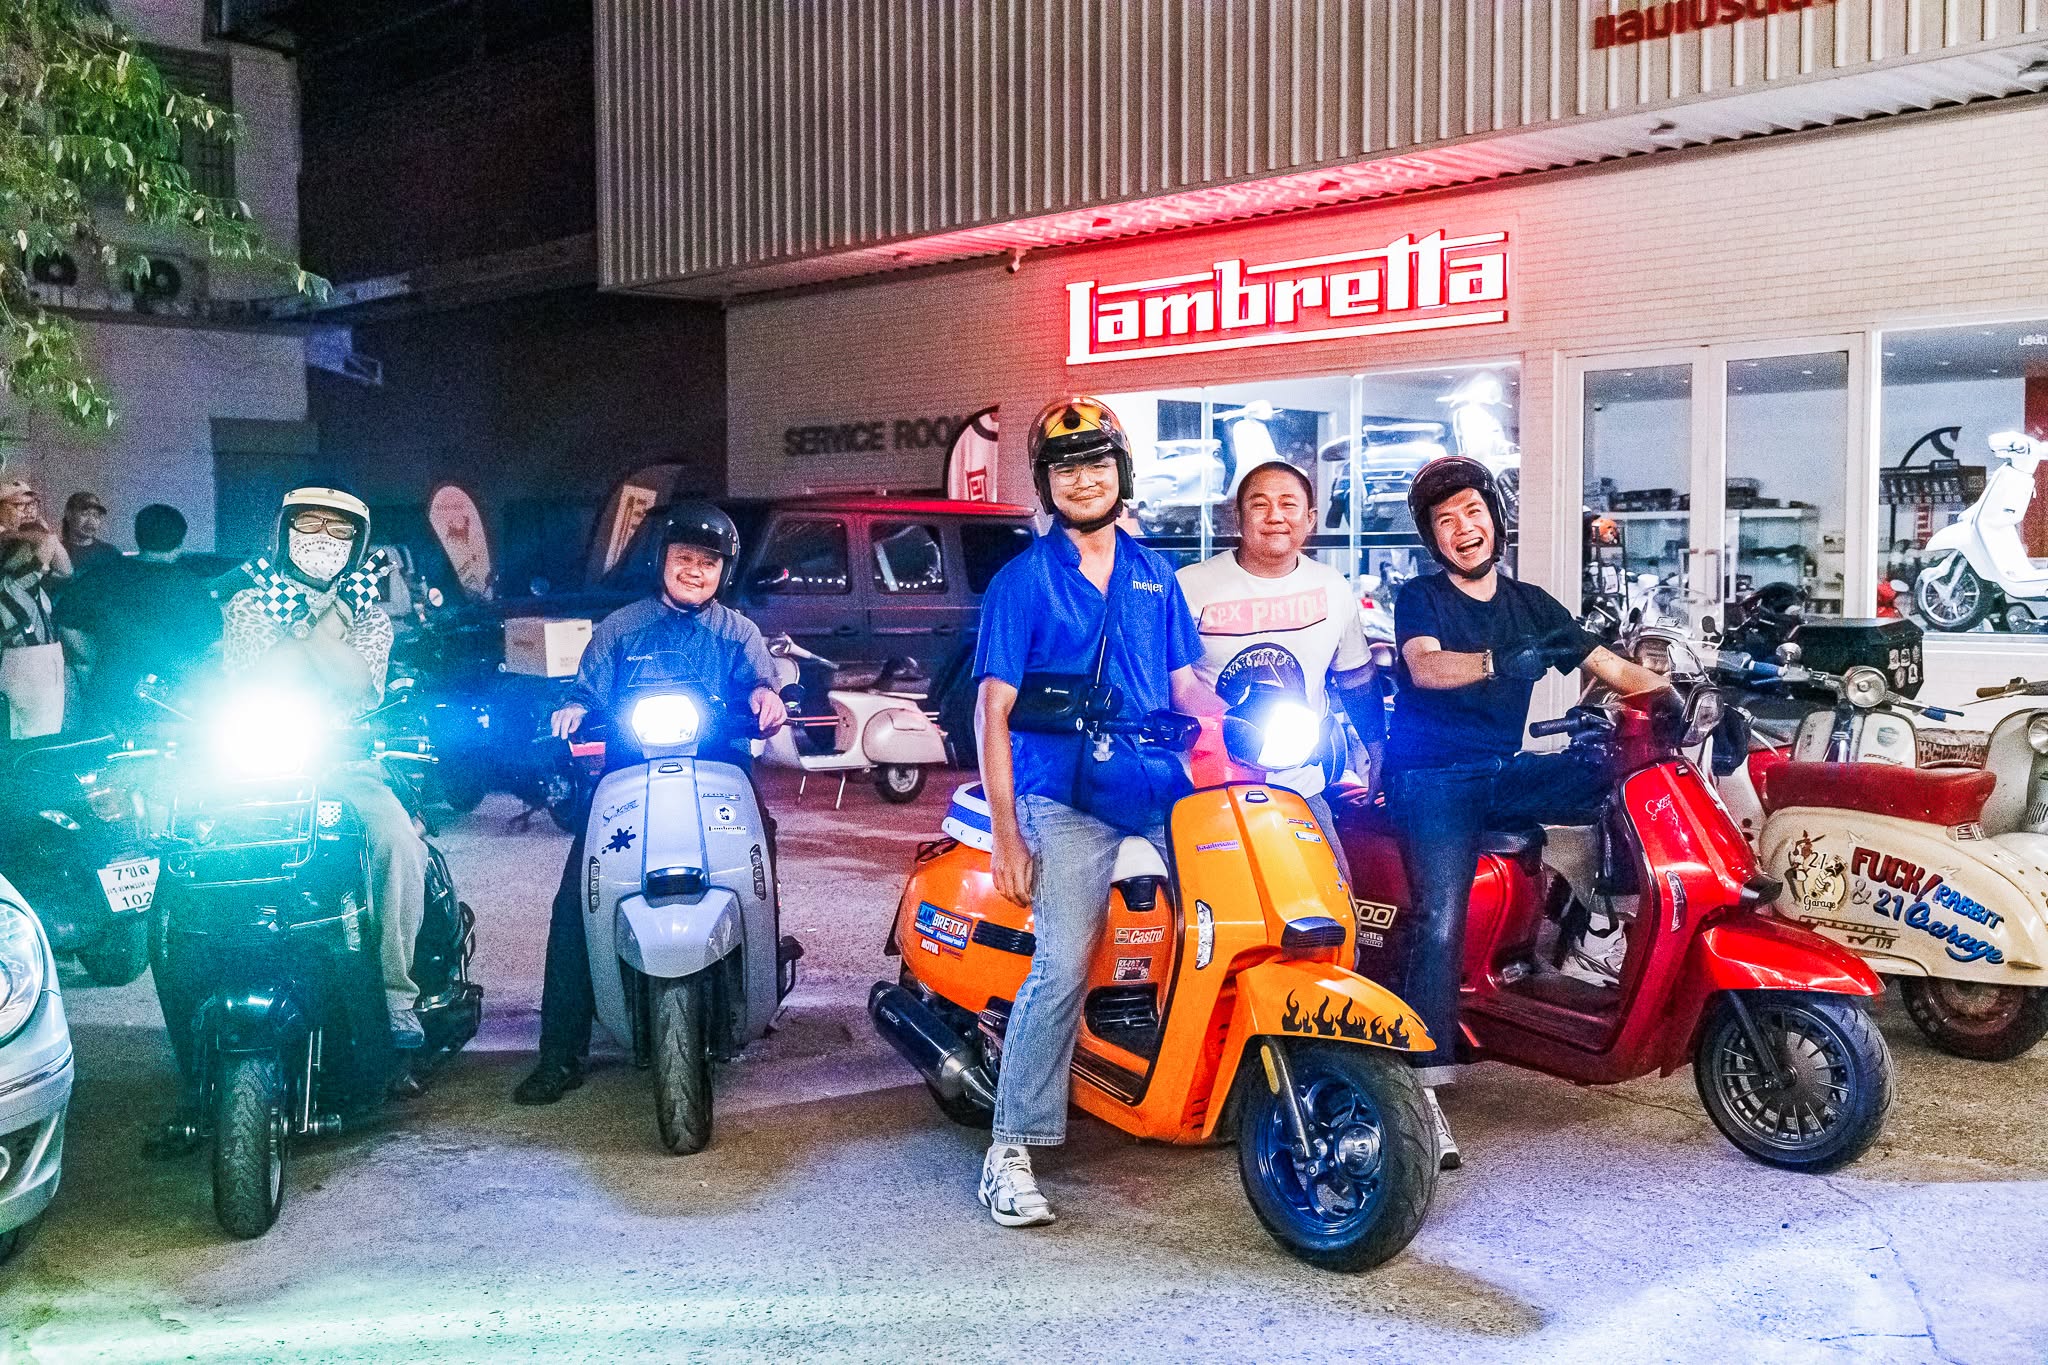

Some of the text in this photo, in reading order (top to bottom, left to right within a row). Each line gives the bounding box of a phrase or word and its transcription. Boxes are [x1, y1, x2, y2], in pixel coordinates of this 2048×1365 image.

[784, 420, 885, 457] SERVICE
[1132, 580, 1164, 595] meijer
[1808, 852, 1827, 870] 21
[1851, 847, 2005, 929] FUCK! RABBIT
[1803, 896, 1837, 912] Garage
[1356, 904, 1391, 924] 00
[1130, 928, 1165, 943] Castrol
[1873, 888, 1905, 922] 21
[1904, 902, 2005, 965] Garage
